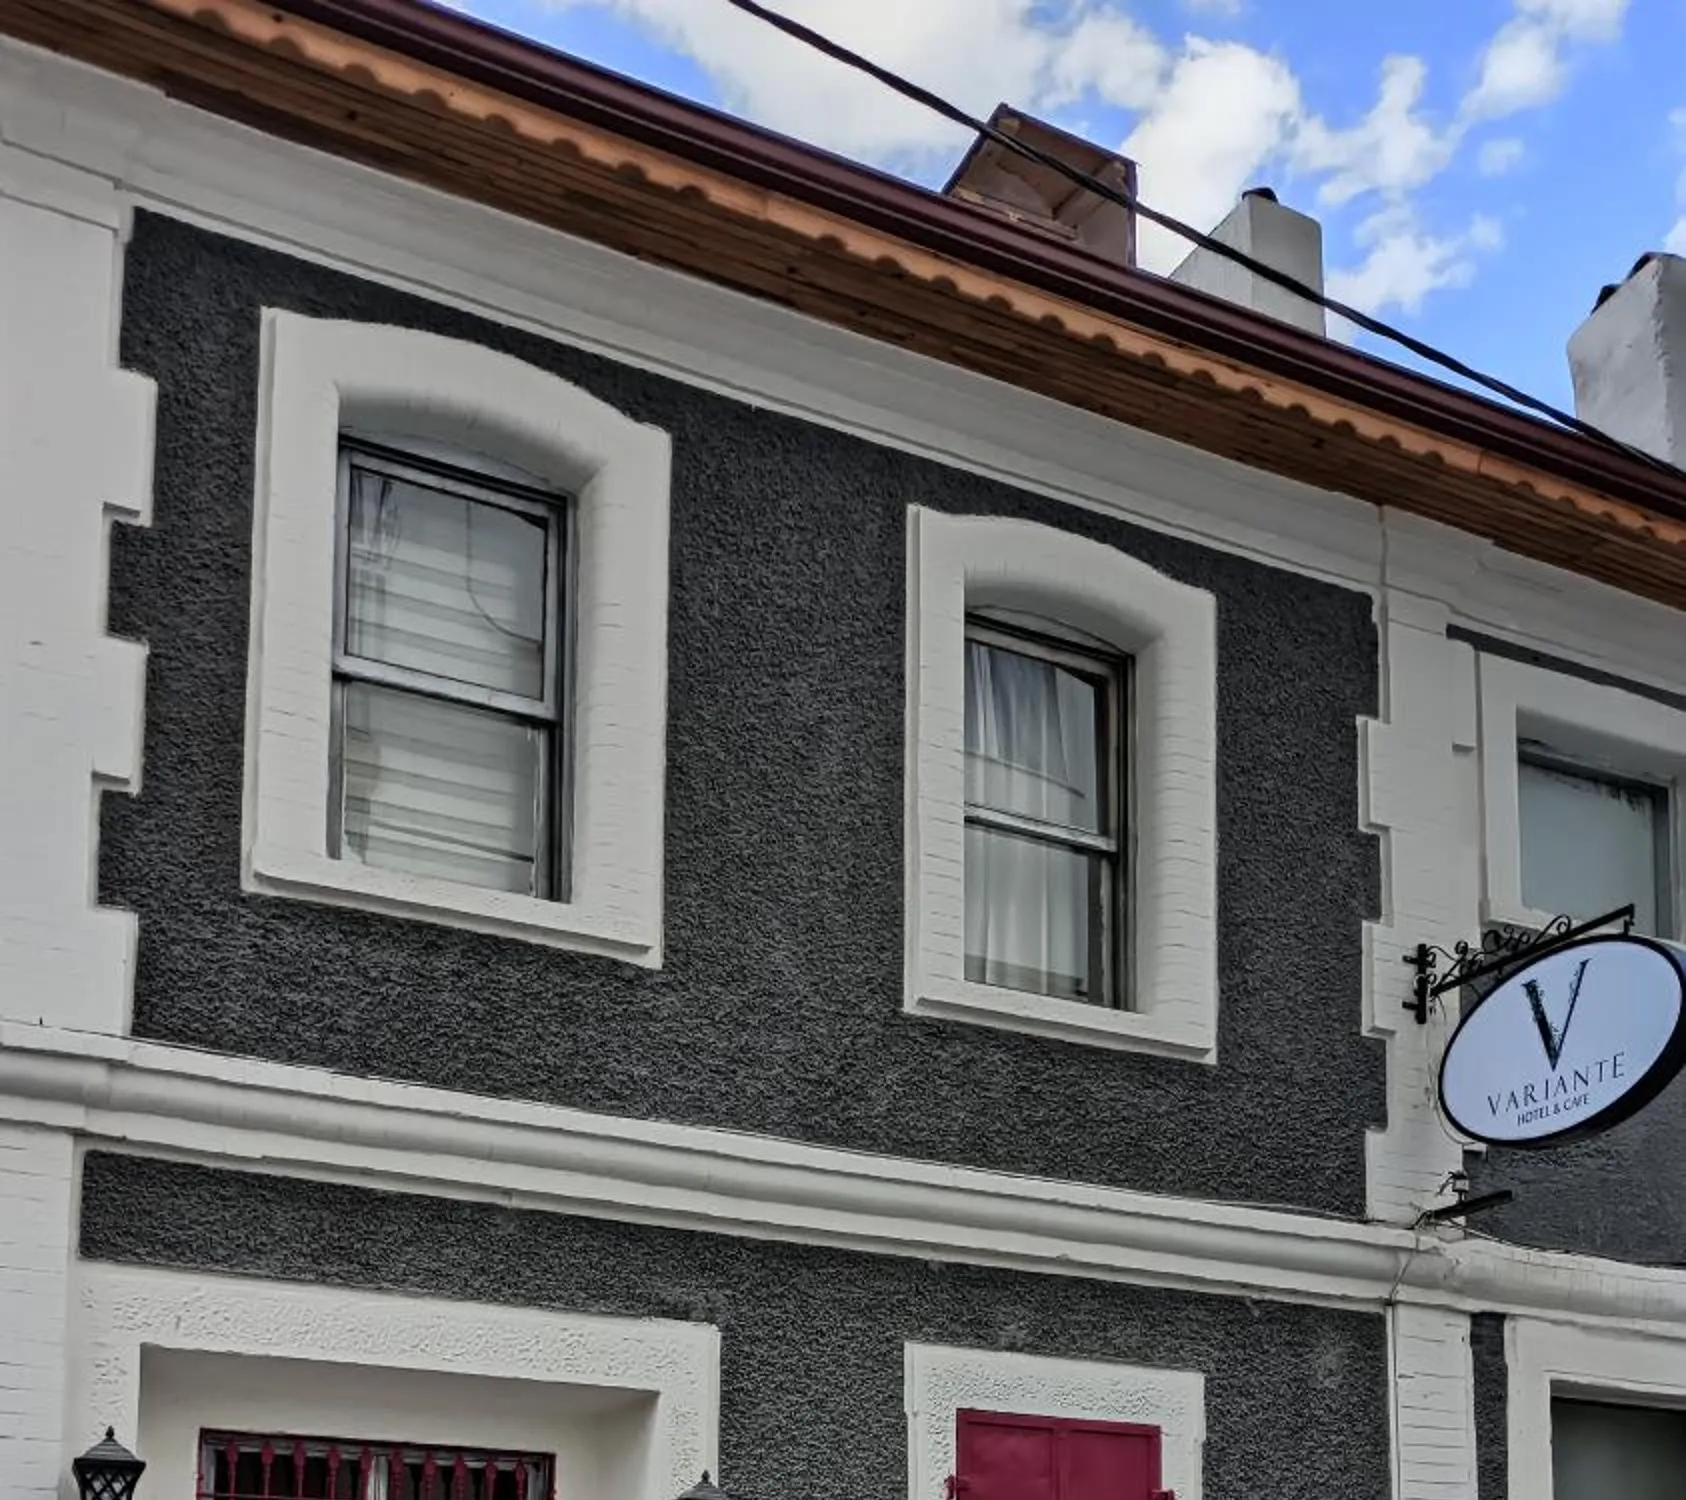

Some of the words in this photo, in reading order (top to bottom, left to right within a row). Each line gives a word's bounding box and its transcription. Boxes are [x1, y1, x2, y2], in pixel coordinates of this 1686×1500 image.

[1522, 958, 1591, 1072] V
[1487, 1051, 1625, 1116] VARIANTE
[1517, 1105, 1551, 1126] HOTEL
[1553, 1103, 1561, 1115] &
